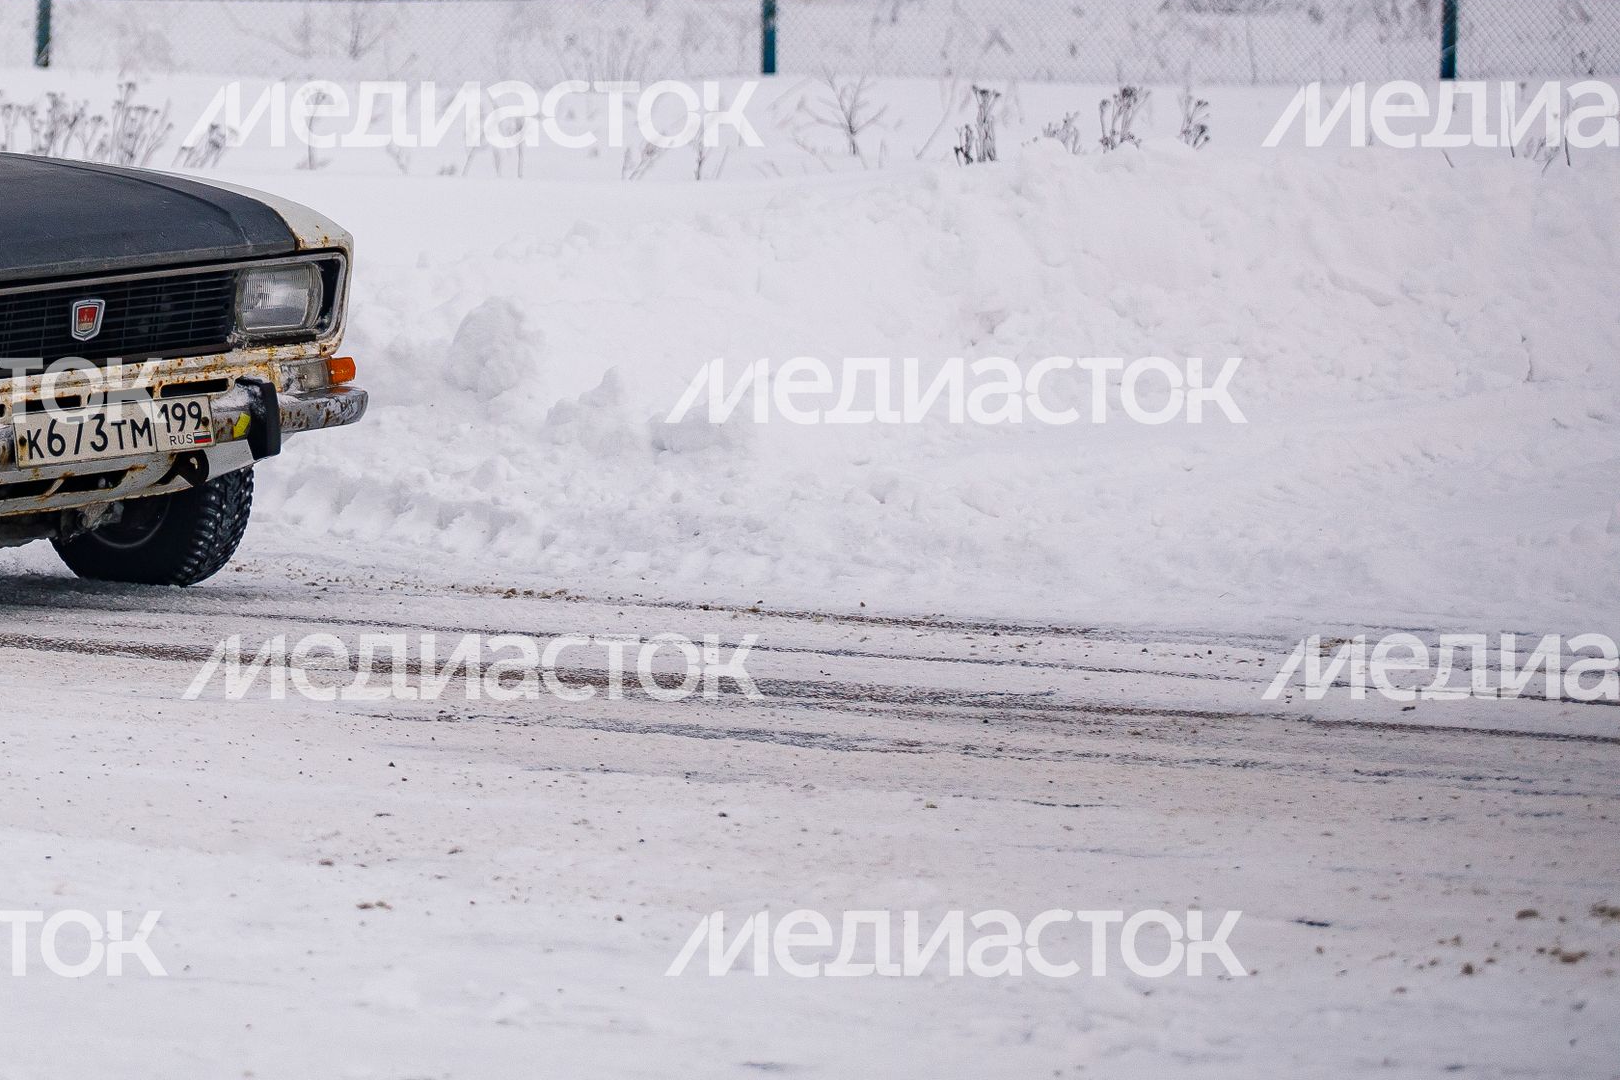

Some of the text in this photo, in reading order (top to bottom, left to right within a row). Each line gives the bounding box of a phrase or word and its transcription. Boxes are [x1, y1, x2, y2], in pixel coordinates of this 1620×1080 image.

[27, 400, 203, 460] К673ТМ 199
[169, 434, 193, 446] RUS
